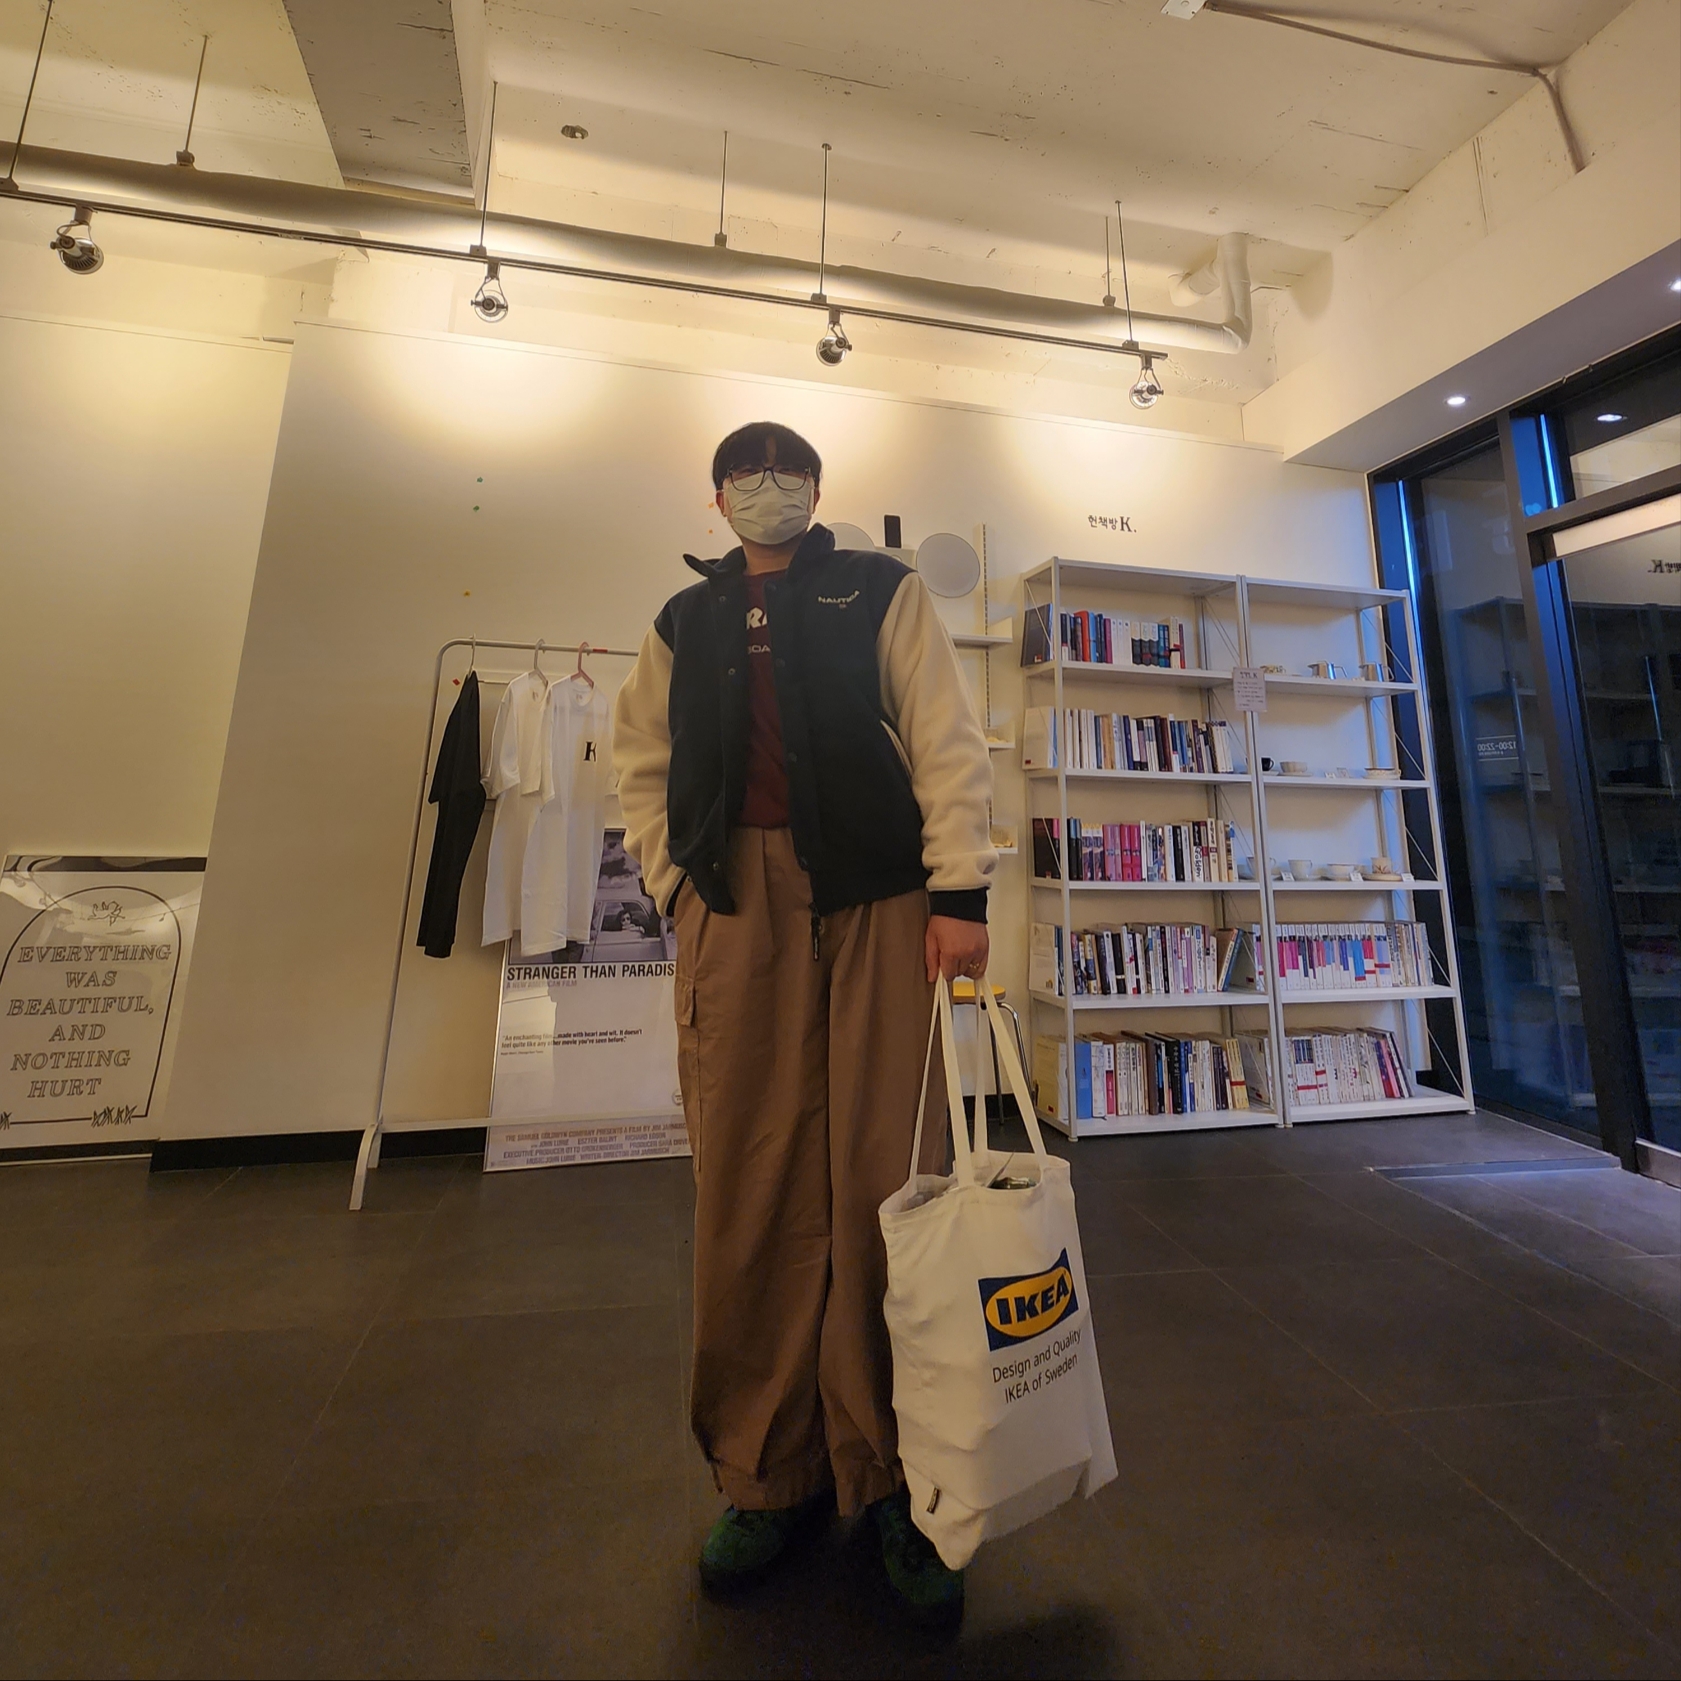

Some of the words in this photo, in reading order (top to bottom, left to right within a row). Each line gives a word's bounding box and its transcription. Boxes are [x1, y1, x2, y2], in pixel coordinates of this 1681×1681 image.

[818, 590, 860, 604] NAUTICA
[18, 944, 172, 963] EVERYTHING
[65, 970, 118, 988] WAS
[507, 966, 576, 980] STRANGER
[582, 964, 616, 978] THAN
[622, 963, 675, 978] PARADIS
[6, 996, 154, 1016] BEAUTIFUL,
[48, 1024, 106, 1042] AND
[10, 1050, 131, 1071] NOTHING
[27, 1078, 102, 1098] HURT
[996, 1274, 1070, 1326] IKEA
[992, 1356, 1031, 1383] Design
[1034, 1347, 1052, 1367] and
[1052, 1328, 1082, 1356] Quality
[1004, 1381, 1030, 1404] IKEA
[1032, 1374, 1043, 1391] of
[1046, 1354, 1078, 1385] Sweden
